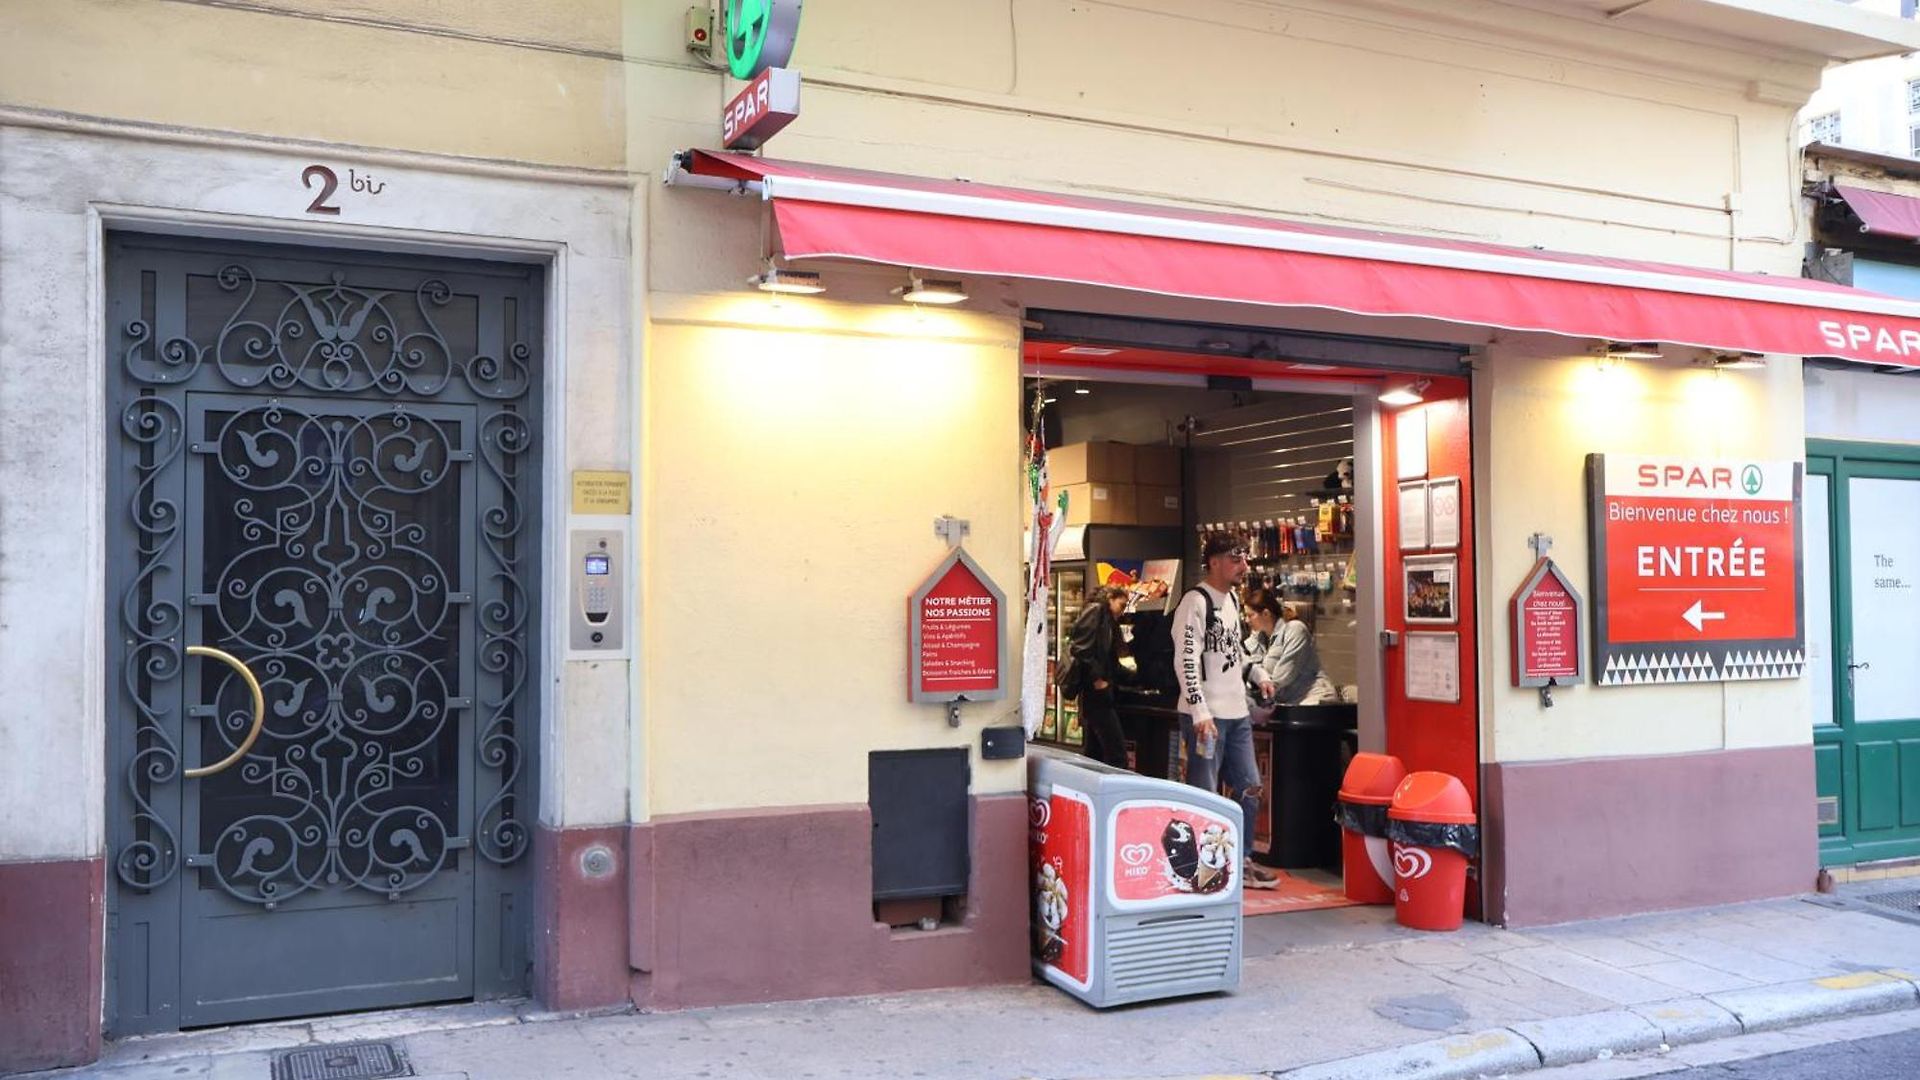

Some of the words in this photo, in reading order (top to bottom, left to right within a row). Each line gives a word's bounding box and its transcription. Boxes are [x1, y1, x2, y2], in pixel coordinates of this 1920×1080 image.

[724, 79, 768, 140] SPAR
[302, 165, 340, 215] 2
[349, 168, 386, 194] bis
[1819, 320, 1920, 356] SPAR
[1638, 464, 1732, 489] SPAR
[1609, 502, 1697, 522] Bienvenue
[1702, 505, 1738, 523] chez
[1743, 511, 1780, 524] nous
[1638, 537, 1766, 577] ENTRÉE
[1873, 554, 1894, 567] The
[1874, 578, 1912, 588] same...
[925, 597, 956, 606] NOTRE
[958, 595, 992, 605] MÉTIER
[926, 608, 945, 617] NOS
[946, 608, 991, 617] PASSIONS
